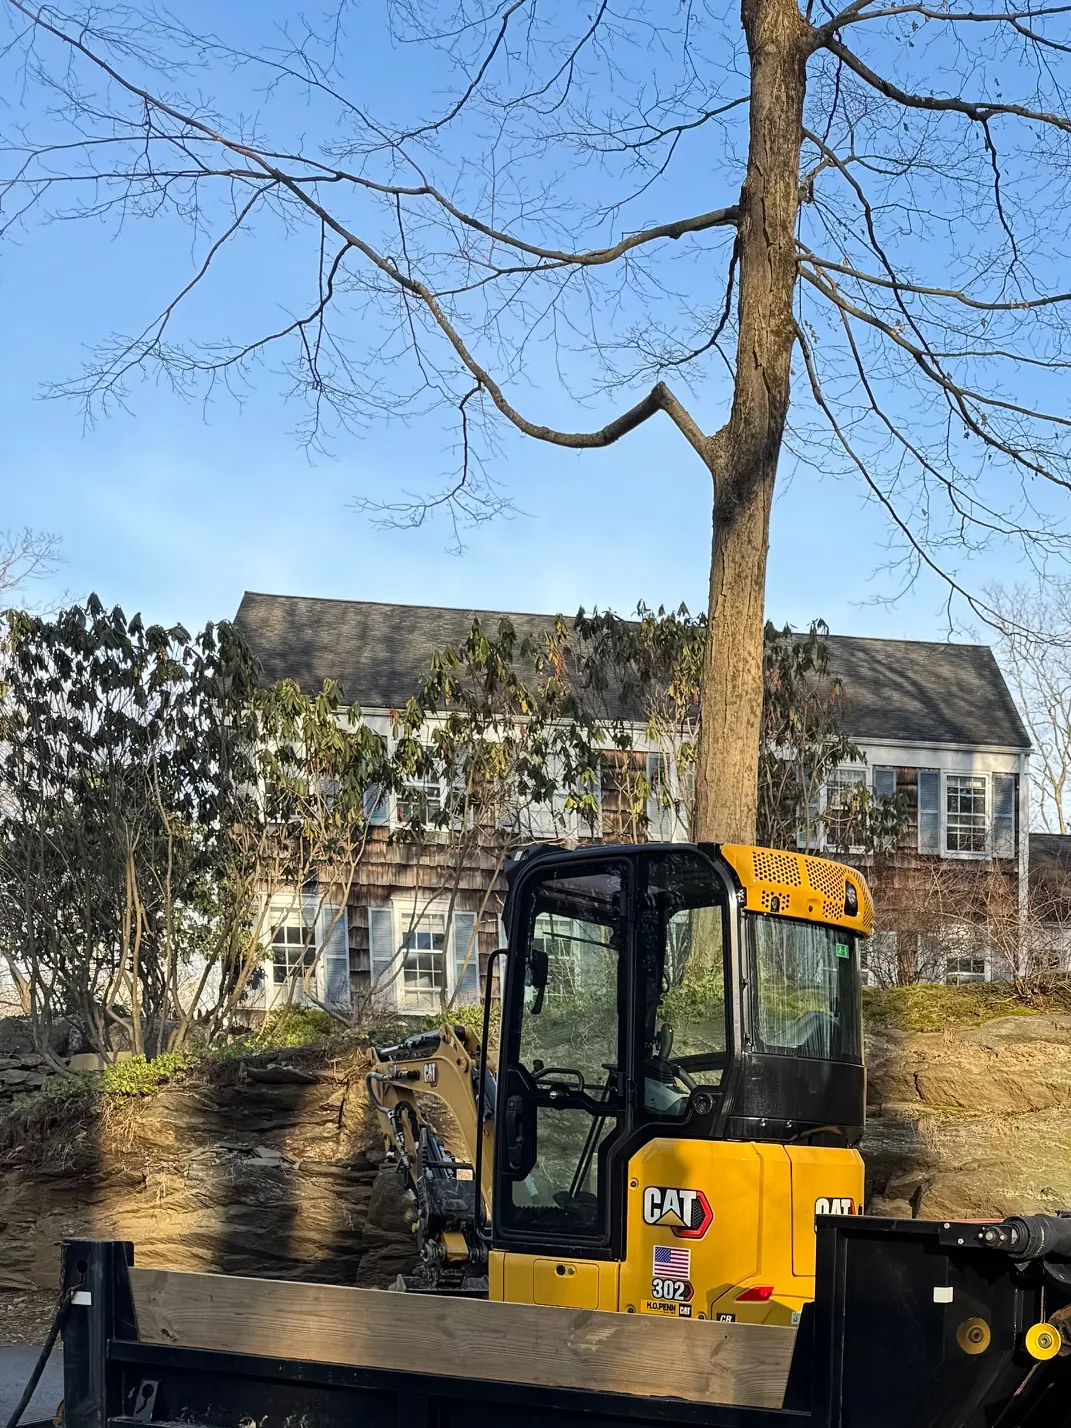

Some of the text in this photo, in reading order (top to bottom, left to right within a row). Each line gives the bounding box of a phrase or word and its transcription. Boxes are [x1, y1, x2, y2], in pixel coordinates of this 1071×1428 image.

[424, 1063, 436, 1082] CAT
[643, 1186, 697, 1228] CAT
[652, 1278, 685, 1301] 302
[679, 1305, 691, 1316] CAT
